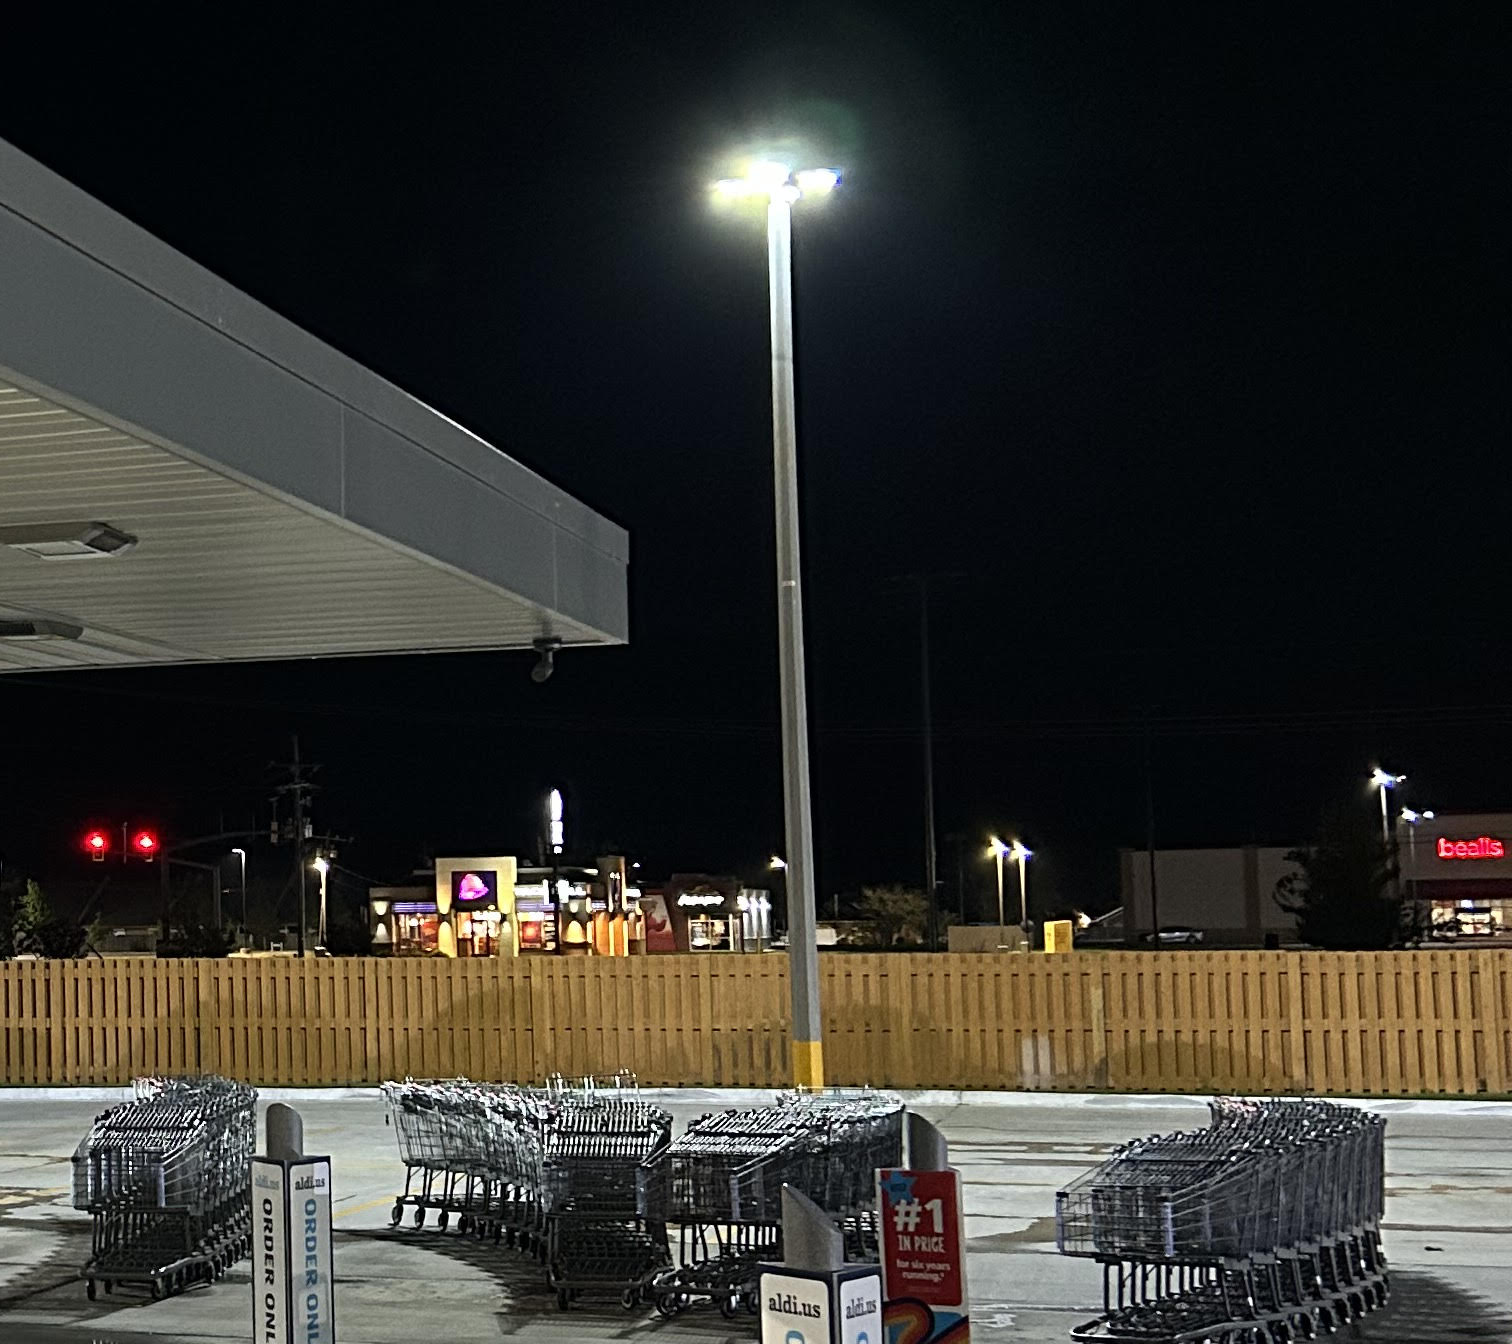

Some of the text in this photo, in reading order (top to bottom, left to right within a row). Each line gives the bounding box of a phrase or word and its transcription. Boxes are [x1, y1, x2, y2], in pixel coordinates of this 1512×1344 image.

[1437, 837, 1505, 859] bealls
[295, 1176, 326, 1190] aldi.us
[893, 1197, 944, 1233] #1
[262, 1198, 274, 1286] ORDER
[304, 1198, 317, 1288] ORDER
[898, 1235, 946, 1253] IN PRICE
[926, 1261, 950, 1273] years
[769, 1293, 821, 1319] aldi.us
[846, 1296, 877, 1319] aldi.us
